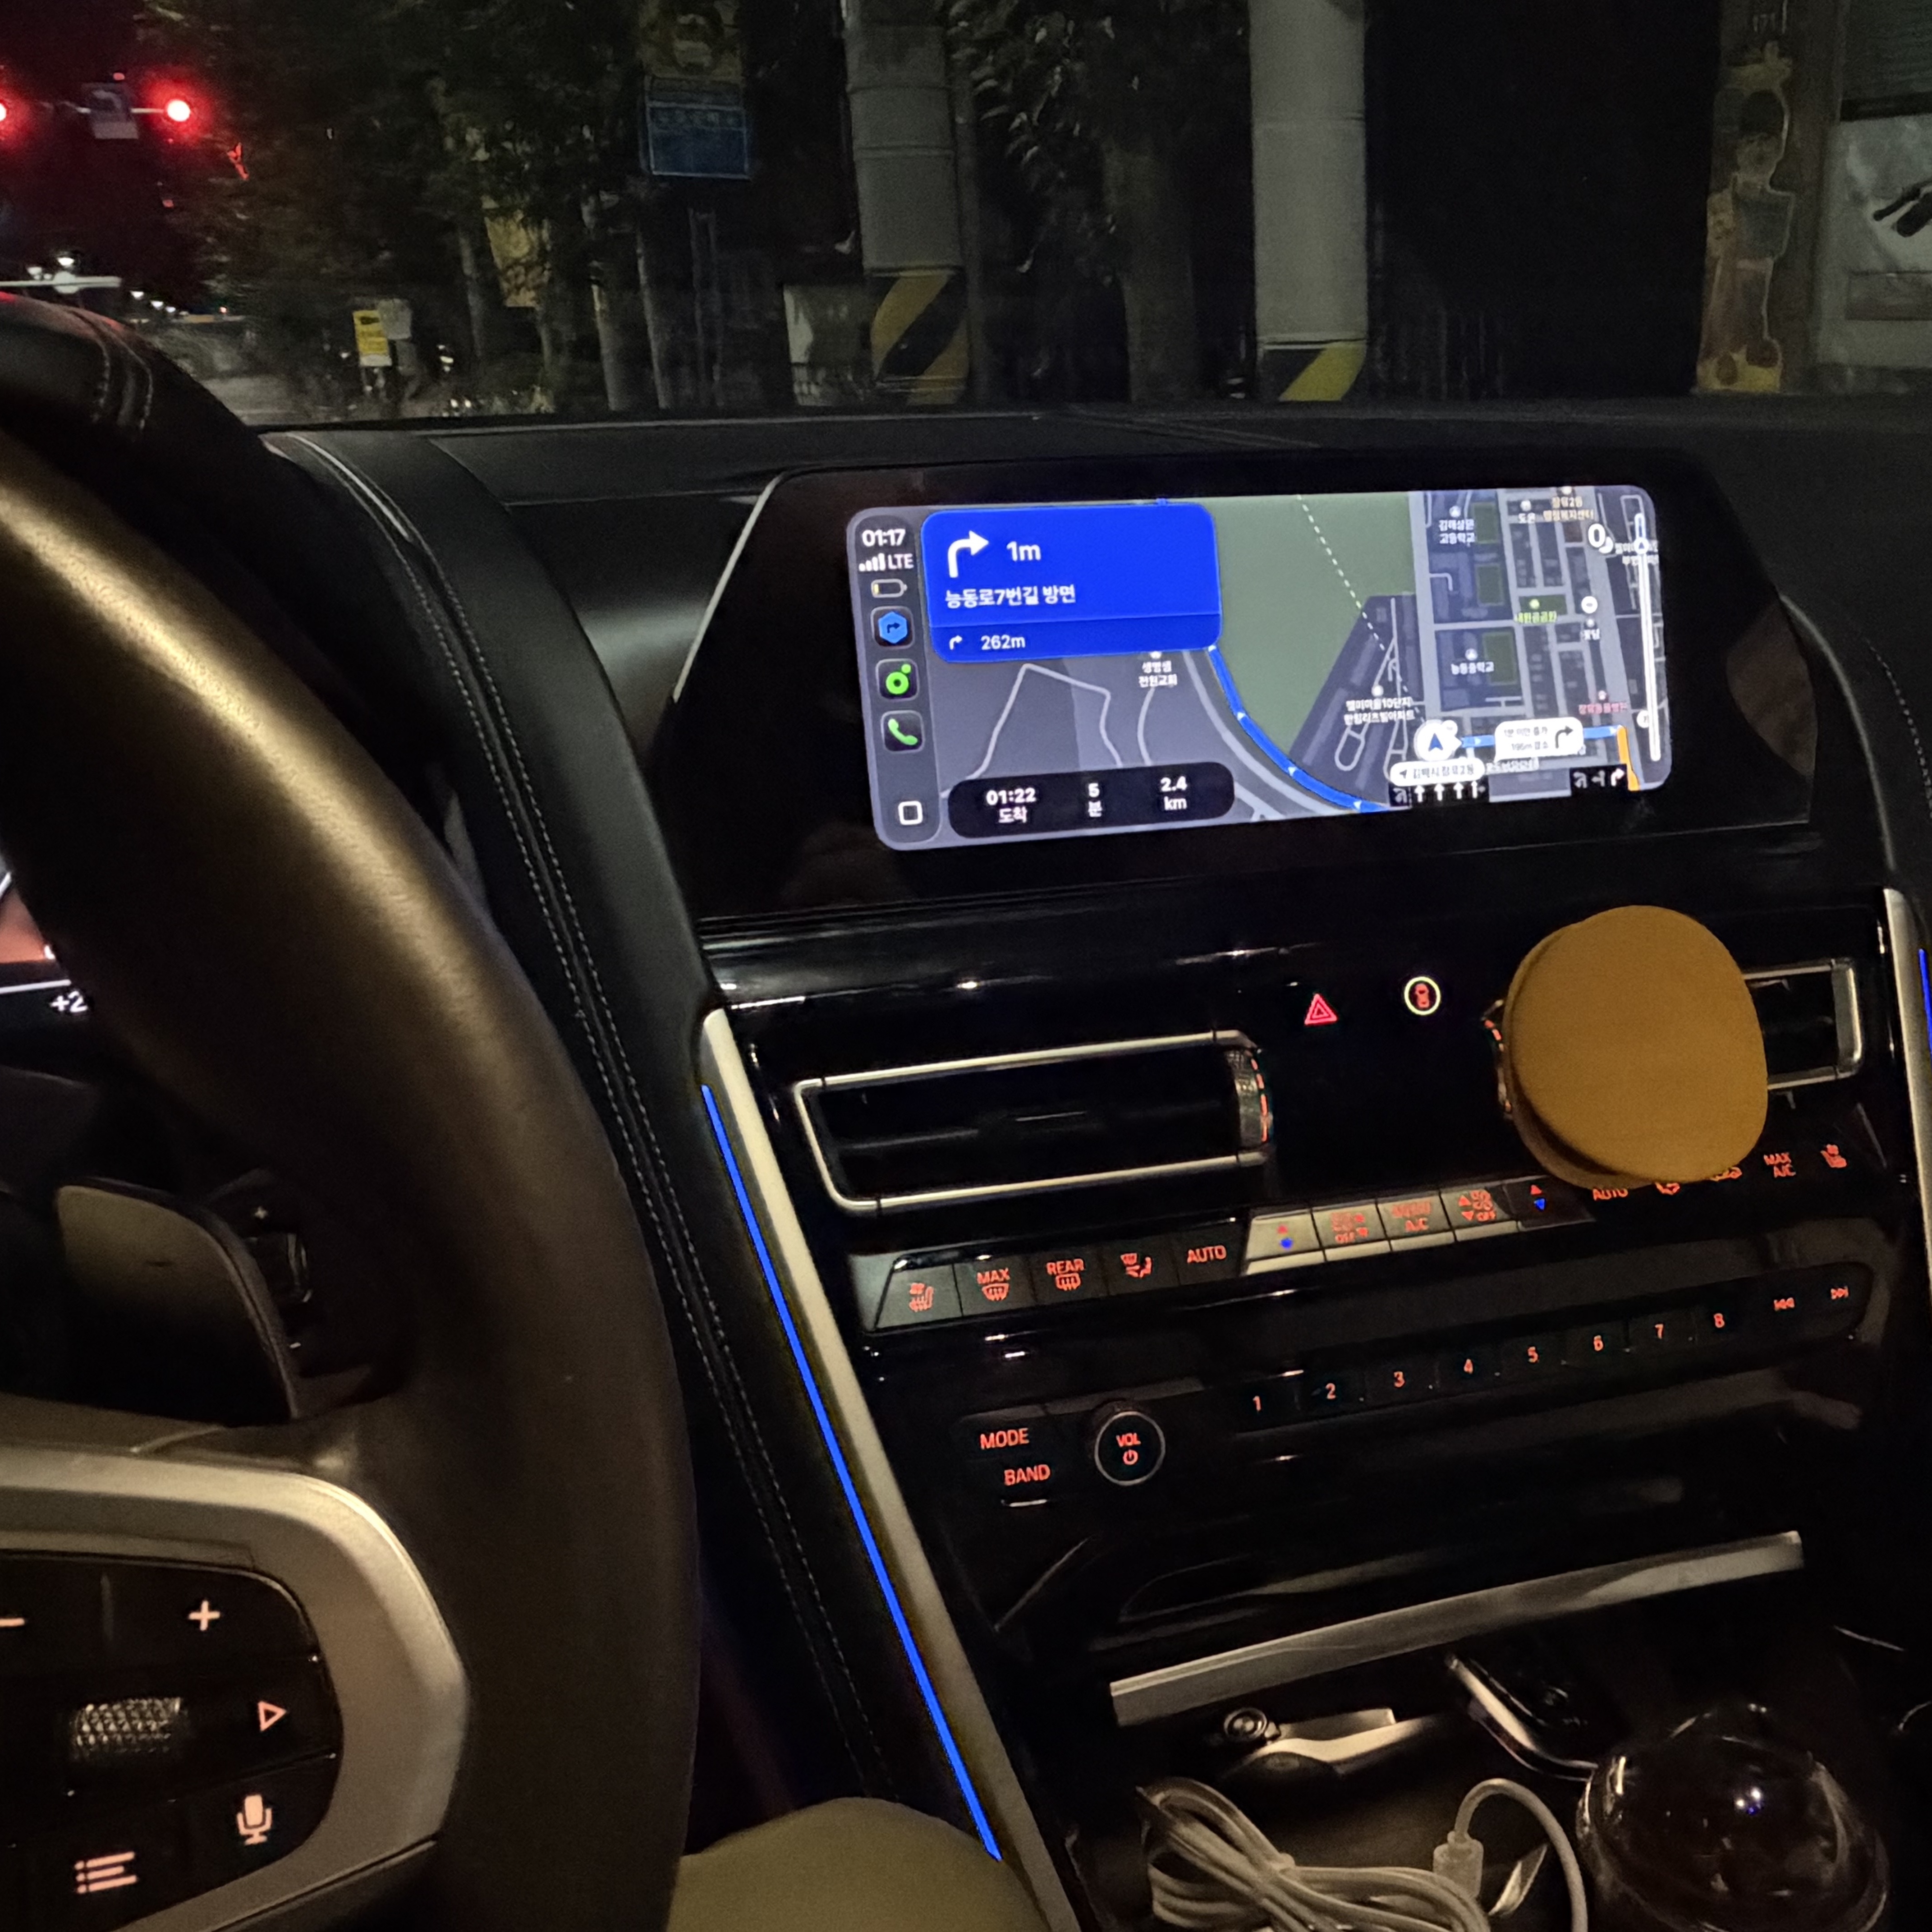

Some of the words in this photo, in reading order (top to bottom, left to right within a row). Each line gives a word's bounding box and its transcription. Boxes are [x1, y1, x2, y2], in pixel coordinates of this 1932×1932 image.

[862, 529, 906, 547] 01:17
[1588, 523, 1606, 547] 0
[1006, 541, 1041, 561] 1m
[888, 553, 913, 569] LTE
[945, 585, 1039, 609] 능동로7번길
[1042, 584, 1076, 605] 방면
[981, 635, 1025, 650] 262m
[1088, 783, 1100, 797] 5
[1160, 776, 1188, 792] 2.4
[986, 787, 1036, 805] 01:22
[1164, 796, 1187, 810] km
[998, 806, 1028, 824] 도착
[1088, 800, 1102, 818] 분
[1763, 1152, 1792, 1166] MAX
[1186, 1245, 1227, 1264] AUTO
[1046, 1258, 1085, 1275] REAR
[977, 1268, 1010, 1284] MAX
[1713, 1313, 1725, 1328] 8
[1655, 1324, 1664, 1339] 7
[1593, 1336, 1604, 1352] 6
[1528, 1347, 1539, 1363] 5
[1464, 1359, 1473, 1374] 4
[1394, 1371, 1405, 1388] 3
[1326, 1383, 1336, 1399] 2
[1253, 1396, 1262, 1412] 1
[979, 1428, 1029, 1449] MODE
[1116, 1432, 1141, 1447] VOL
[1004, 1464, 1051, 1486] BAND
